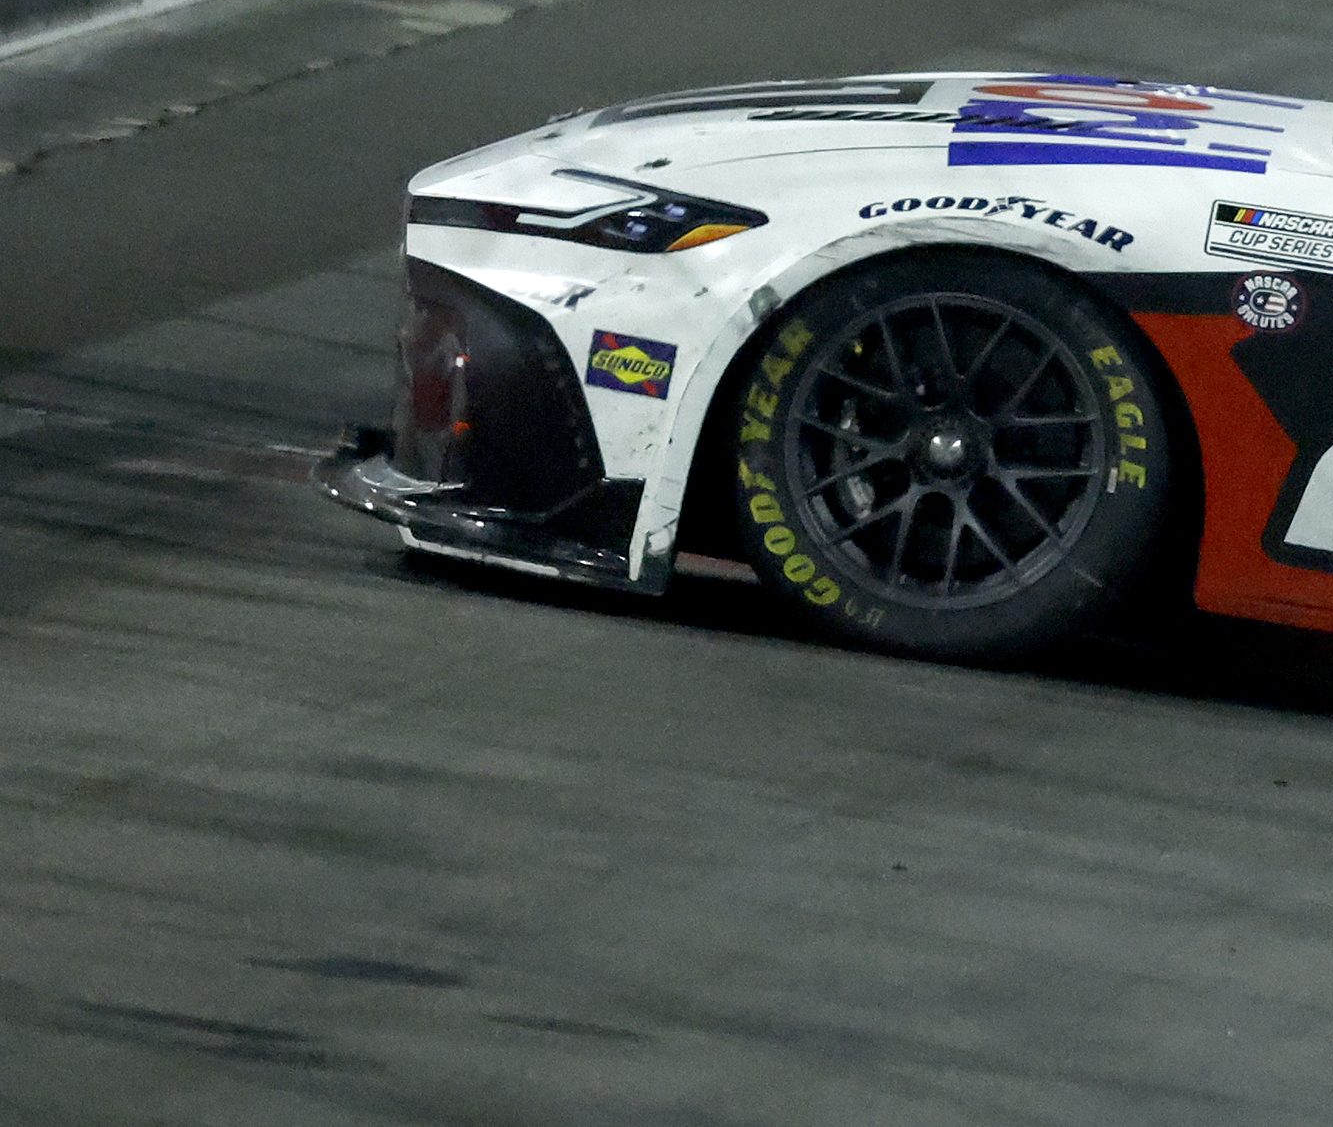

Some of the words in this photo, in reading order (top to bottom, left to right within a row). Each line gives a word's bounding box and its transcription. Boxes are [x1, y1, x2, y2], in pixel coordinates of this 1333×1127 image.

[1228, 229, 1268, 247] CUP
[1243, 274, 1298, 301] NASCAR
[1236, 303, 1295, 330] SALUTES
[593, 352, 668, 378] SUNOCO
[1090, 345, 1147, 489] EAGLE
